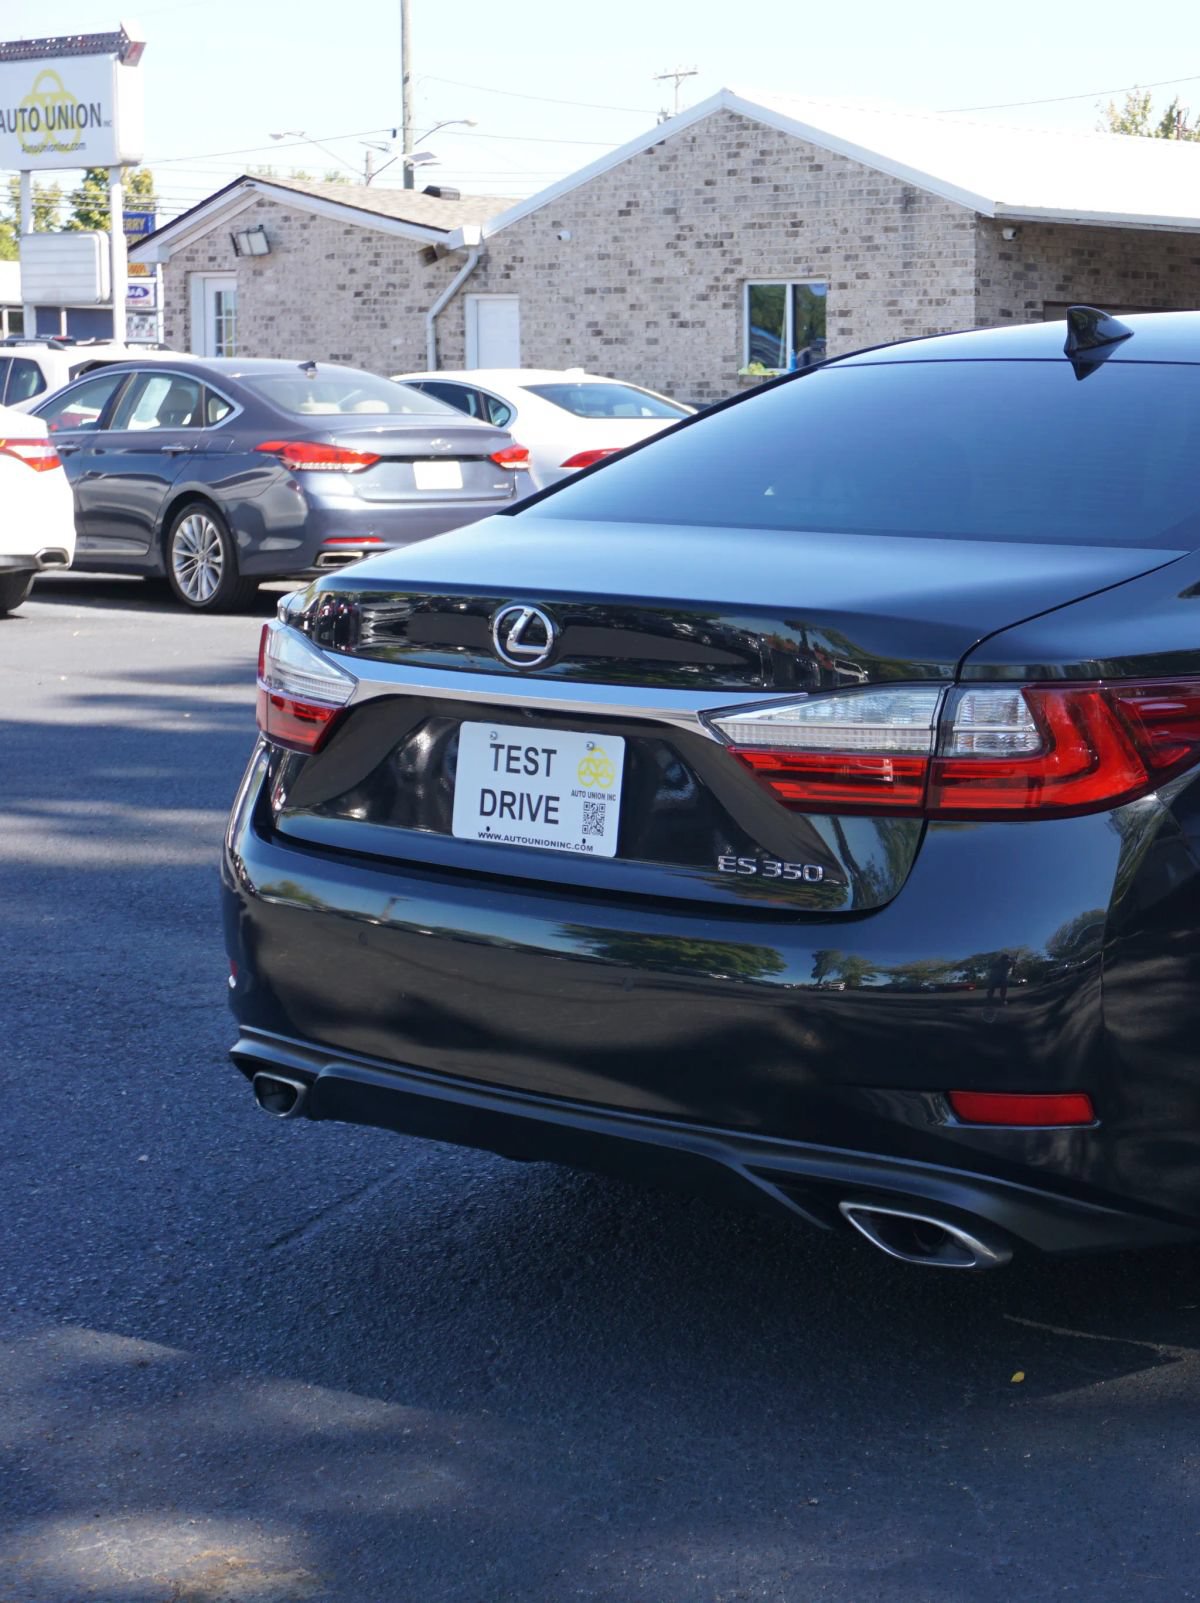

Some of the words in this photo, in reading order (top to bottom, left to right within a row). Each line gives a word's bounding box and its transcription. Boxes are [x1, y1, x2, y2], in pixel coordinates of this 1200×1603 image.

[0, 107, 40, 133] AUTO
[45, 103, 101, 130] UNION
[489, 743, 557, 777] TEST
[479, 788, 560, 825] DRIVE
[571, 789, 586, 799] AUTO
[587, 791, 605, 801] UNION
[606, 793, 616, 802] INC
[478, 831, 594, 853] WWW.AUTOUNIONINC.COM
[718, 855, 757, 875] ES
[762, 860, 823, 882] 350
